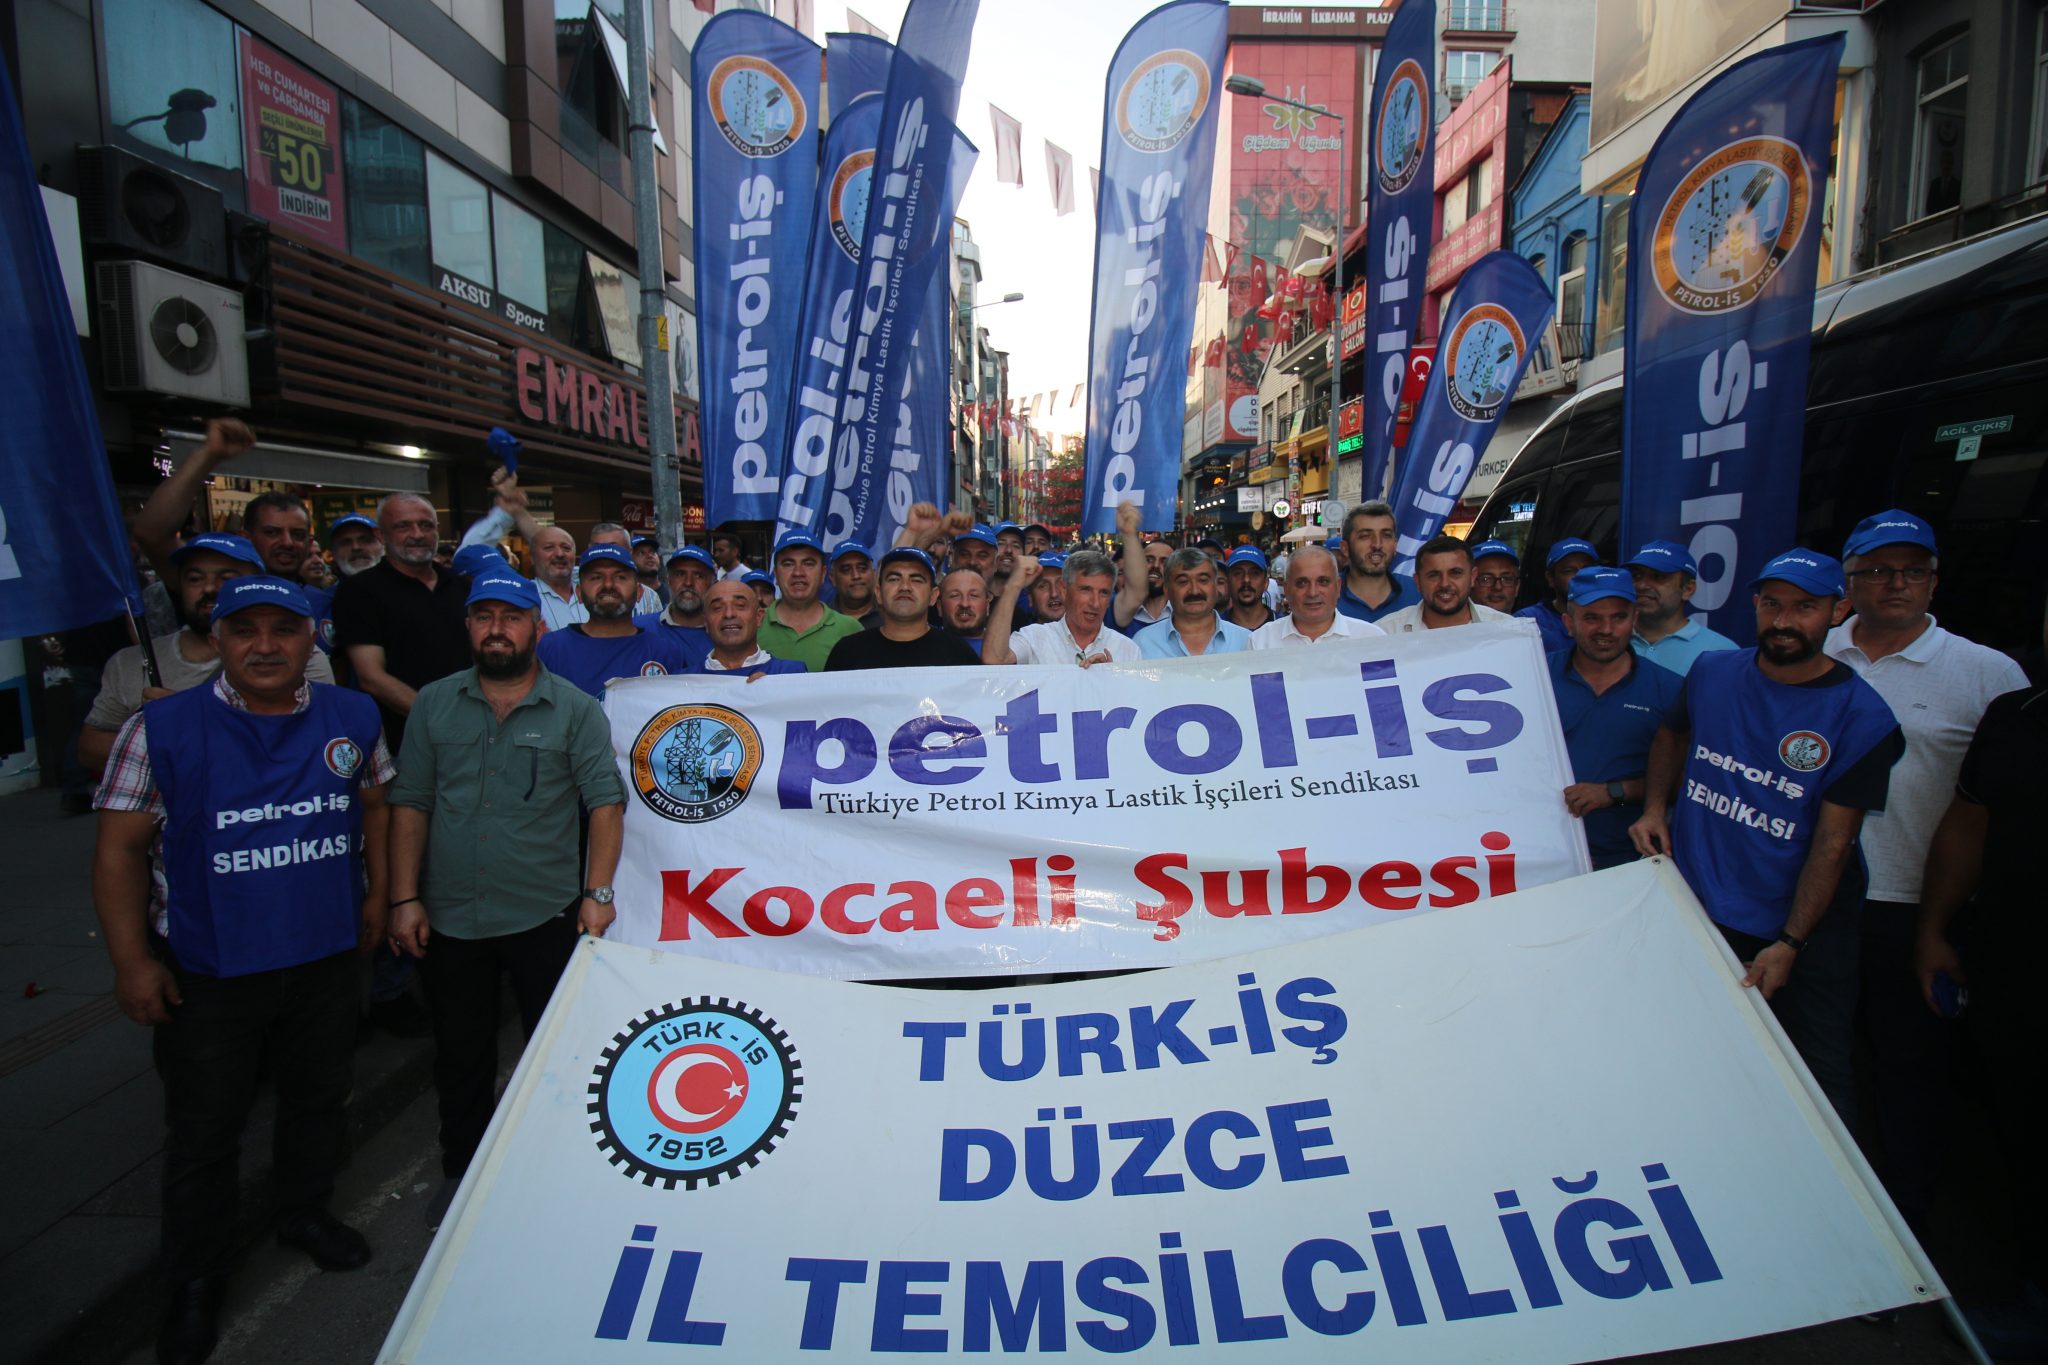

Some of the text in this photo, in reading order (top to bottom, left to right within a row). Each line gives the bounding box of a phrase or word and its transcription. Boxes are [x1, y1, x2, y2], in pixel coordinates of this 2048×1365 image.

[1262, 8, 1302, 24] İBRAHİM
[1311, 9, 1355, 24] İLKBAHAR
[250, 55, 331, 114] HER CUMARTESİ
[258, 79, 326, 127] ve ÇARŞAMBA
[281, 190, 330, 220] İNDİRİM
[899, 162, 925, 250] Sendikası
[440, 273, 492, 310] AKSU
[505, 302, 545, 332] Sport
[1674, 287, 1742, 308] PETROL-İŞ
[730, 174, 784, 494] petrol-iş
[822, 97, 929, 553] petrol-iş
[878, 317, 894, 368] Lastik
[1102, 171, 1181, 508] petrol-iş
[867, 373, 885, 424] Kimya
[860, 428, 877, 475] Petrol
[1941, 420, 2008, 438] ACİL ÇIKIŞ
[234, 583, 291, 595] petrol-iş
[777, 659, 1524, 809] petrol-iş
[819, 770, 1421, 820] Türkiye Petrol Kimya Lastik İşçileri Sendikası
[1694, 744, 1805, 800] petrol-iş
[216, 793, 351, 830] petrol-iş
[650, 791, 740, 819] PETROL-İŞ 1950
[1687, 779, 1796, 840] SENDİKASI
[658, 831, 1518, 942] Kocaeli Şubesi
[902, 972, 1348, 1081] TÜRK-İŞ
[645, 1132, 728, 1161] 1952
[939, 1098, 1350, 1202] DÜZCE
[594, 1162, 1724, 1354] İL TEMSİLCİLİĞİ
